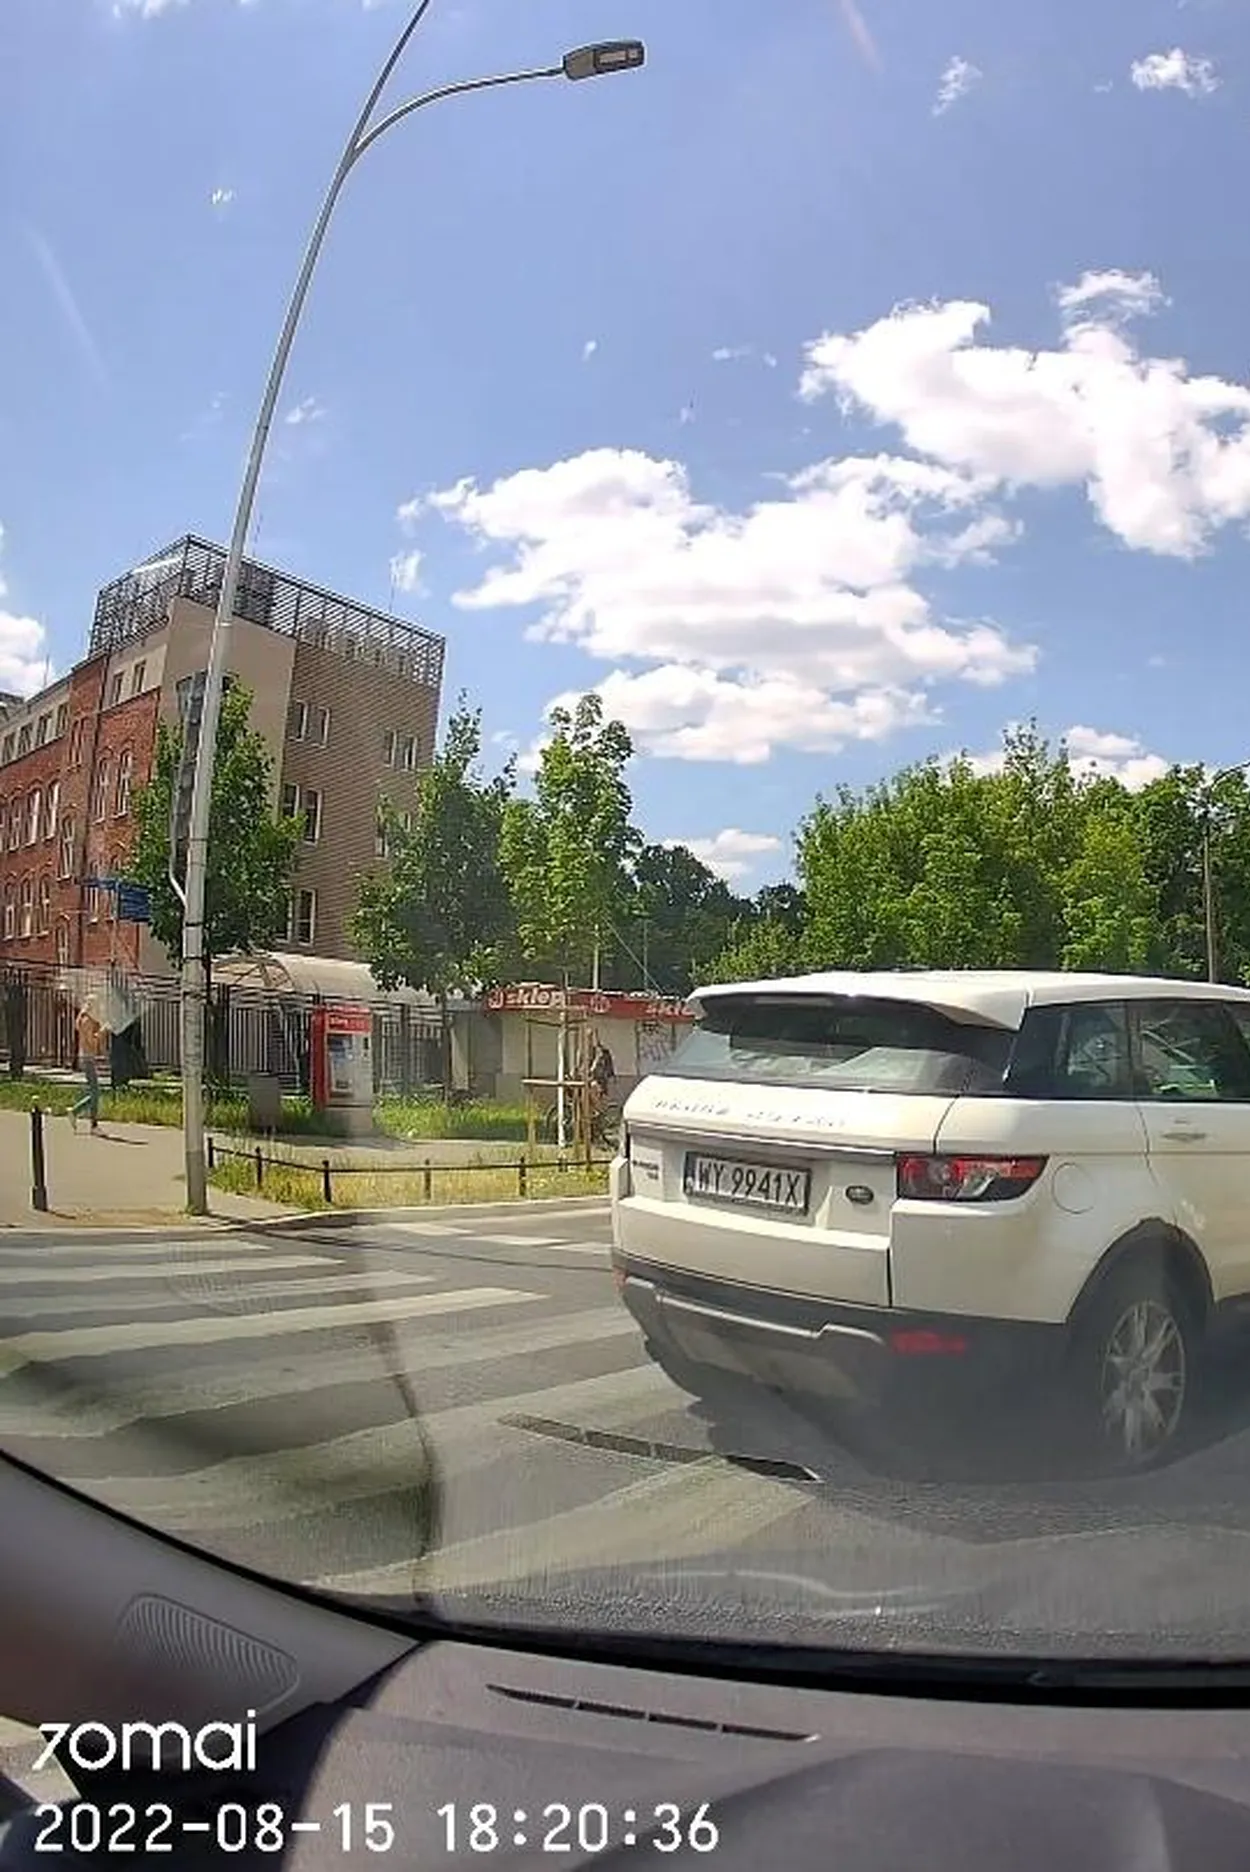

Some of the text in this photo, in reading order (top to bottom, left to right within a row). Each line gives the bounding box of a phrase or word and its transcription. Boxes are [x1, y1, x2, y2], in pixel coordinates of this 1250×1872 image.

[506, 987, 566, 1009] sklep
[698, 1160, 725, 1192] WY
[731, 1166, 801, 1206] 9941X
